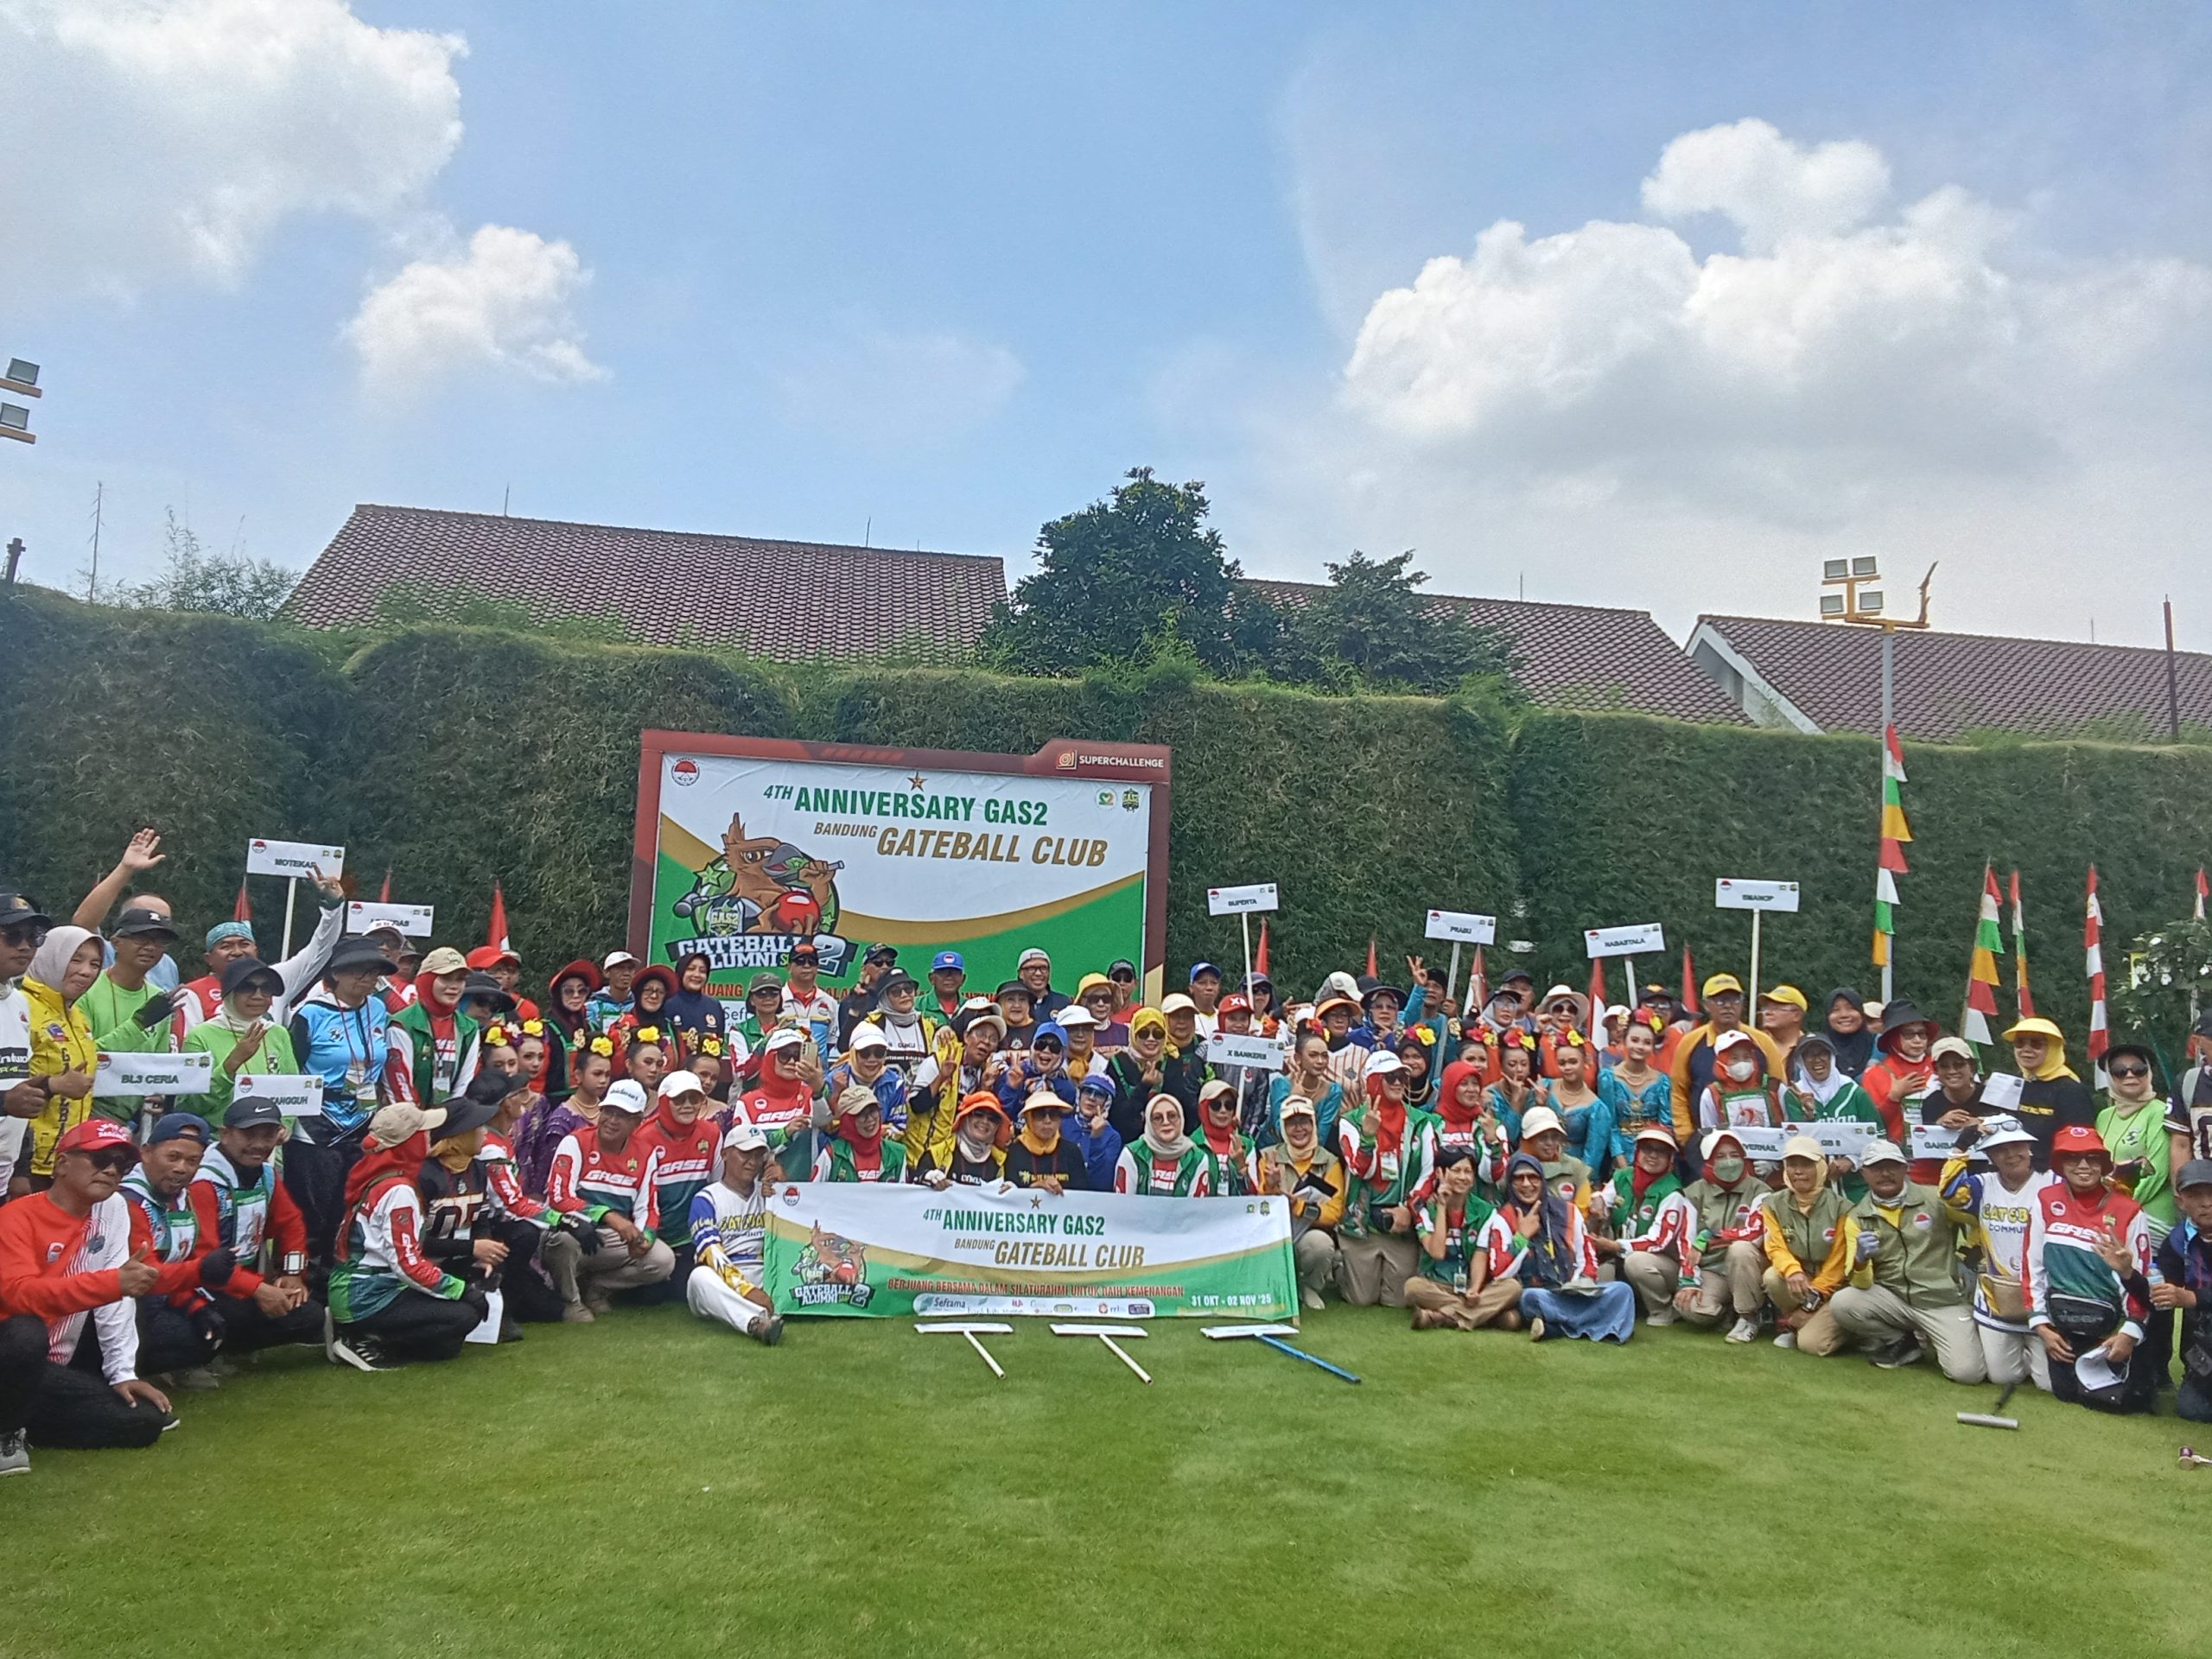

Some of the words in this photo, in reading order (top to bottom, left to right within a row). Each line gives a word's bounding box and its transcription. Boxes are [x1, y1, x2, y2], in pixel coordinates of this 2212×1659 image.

[1078, 754, 1165, 768] SUPERCHALLENGE
[764, 785, 793, 800] 4TH
[794, 787, 976, 822] ANNIVERSARY
[983, 798, 1048, 826] GAS2
[814, 822, 878, 838] BANDUNG
[877, 827, 1020, 862] GATEBALL
[1032, 836, 1108, 867] CLUB
[710, 910, 739, 926] GAS2
[709, 951, 778, 969] LUMNI
[701, 982, 743, 997] JUANG
[122, 1075, 143, 1084] BL3
[145, 1075, 179, 1084] CERIA
[658, 1159, 709, 1174] GAS2
[923, 1209, 942, 1221] 4TH
[943, 1210, 1058, 1234] ANNIVERSARY
[1064, 1215, 1105, 1236] GAS2
[2046, 1221, 2099, 1241] GAS
[954, 1238, 995, 1250] BANDUNG
[995, 1240, 1088, 1268] GATEBALL
[1095, 1244, 1145, 1268] CLUB
[794, 1284, 853, 1298] GATEBALL
[887, 1278, 933, 1292] BERJUANG
[936, 1281, 976, 1294] BERSAMA
[979, 1282, 1007, 1294] DALAM
[1011, 1283, 1068, 1296] SILATURAHMI
[1071, 1285, 1099, 1296] UNTUK
[1102, 1286, 1122, 1296] RAIH
[1126, 1286, 1184, 1297] KEMENANGAN
[802, 1294, 840, 1306] ALUMNI
[934, 1297, 966, 1308] Seftama
[1191, 1296, 1201, 1306] 31
[1204, 1295, 1219, 1306] OKT
[1227, 1295, 1237, 1306] 02
[1240, 1295, 1256, 1306] NOV
[1258, 1294, 1272, 1304] '25
